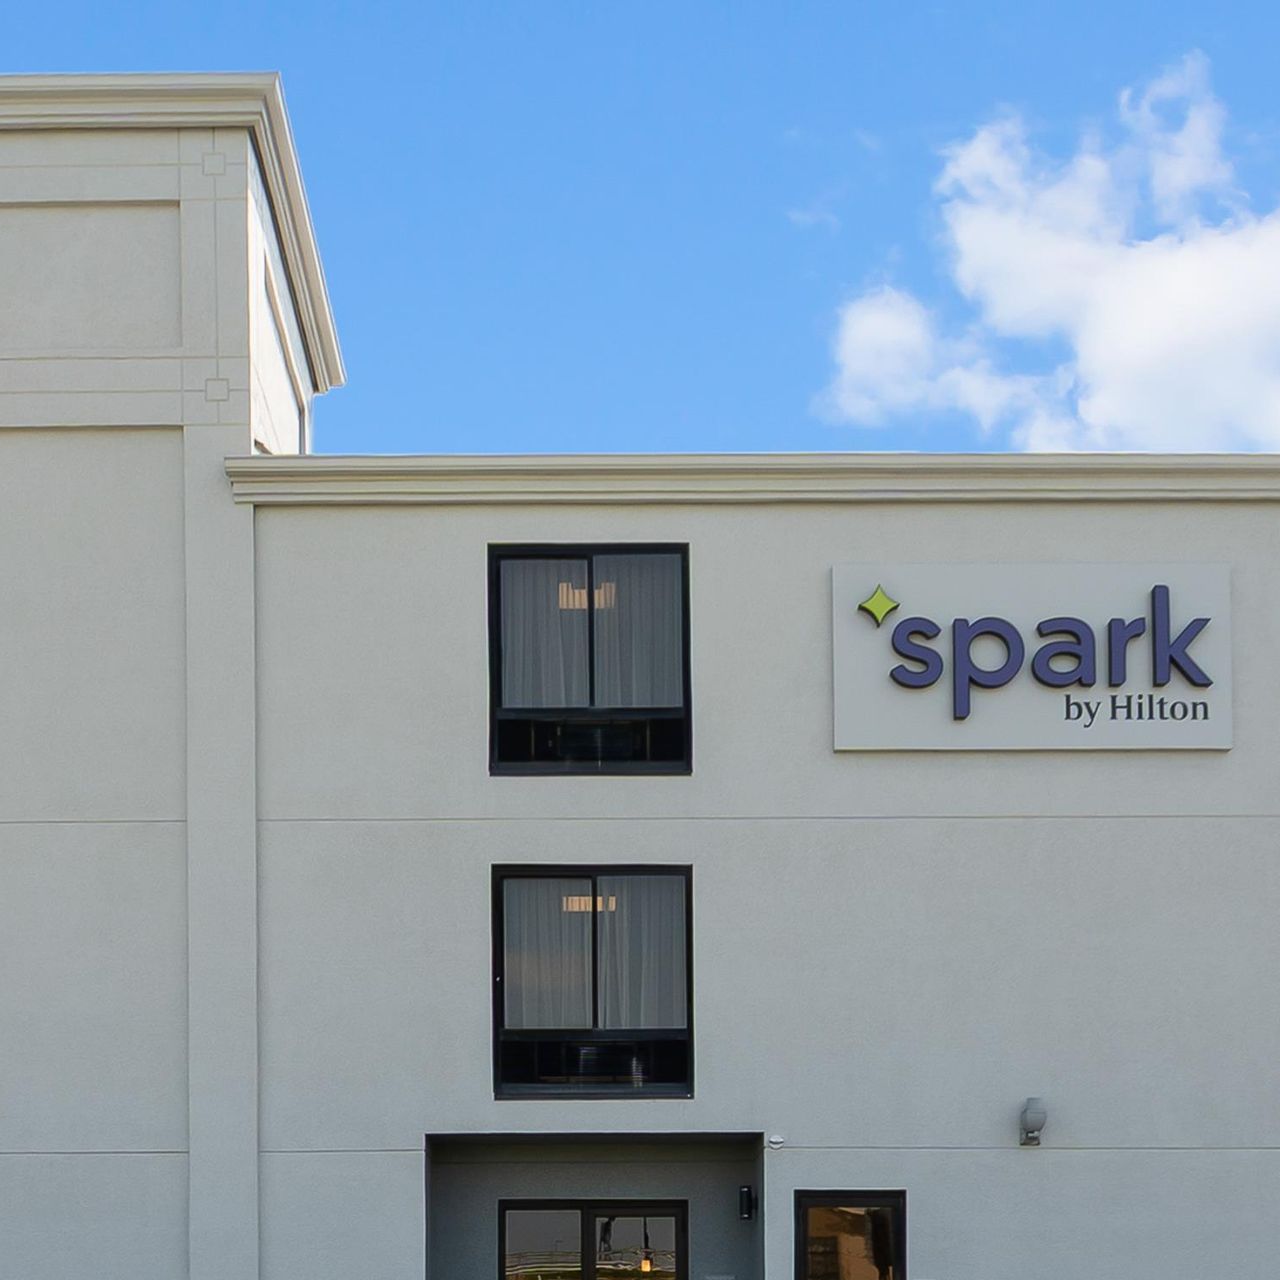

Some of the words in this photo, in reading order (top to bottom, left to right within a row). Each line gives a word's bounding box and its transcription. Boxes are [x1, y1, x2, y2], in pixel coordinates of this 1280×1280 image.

[889, 584, 1214, 721] spark
[1064, 694, 1101, 728] by
[1110, 694, 1210, 721] Hilton
